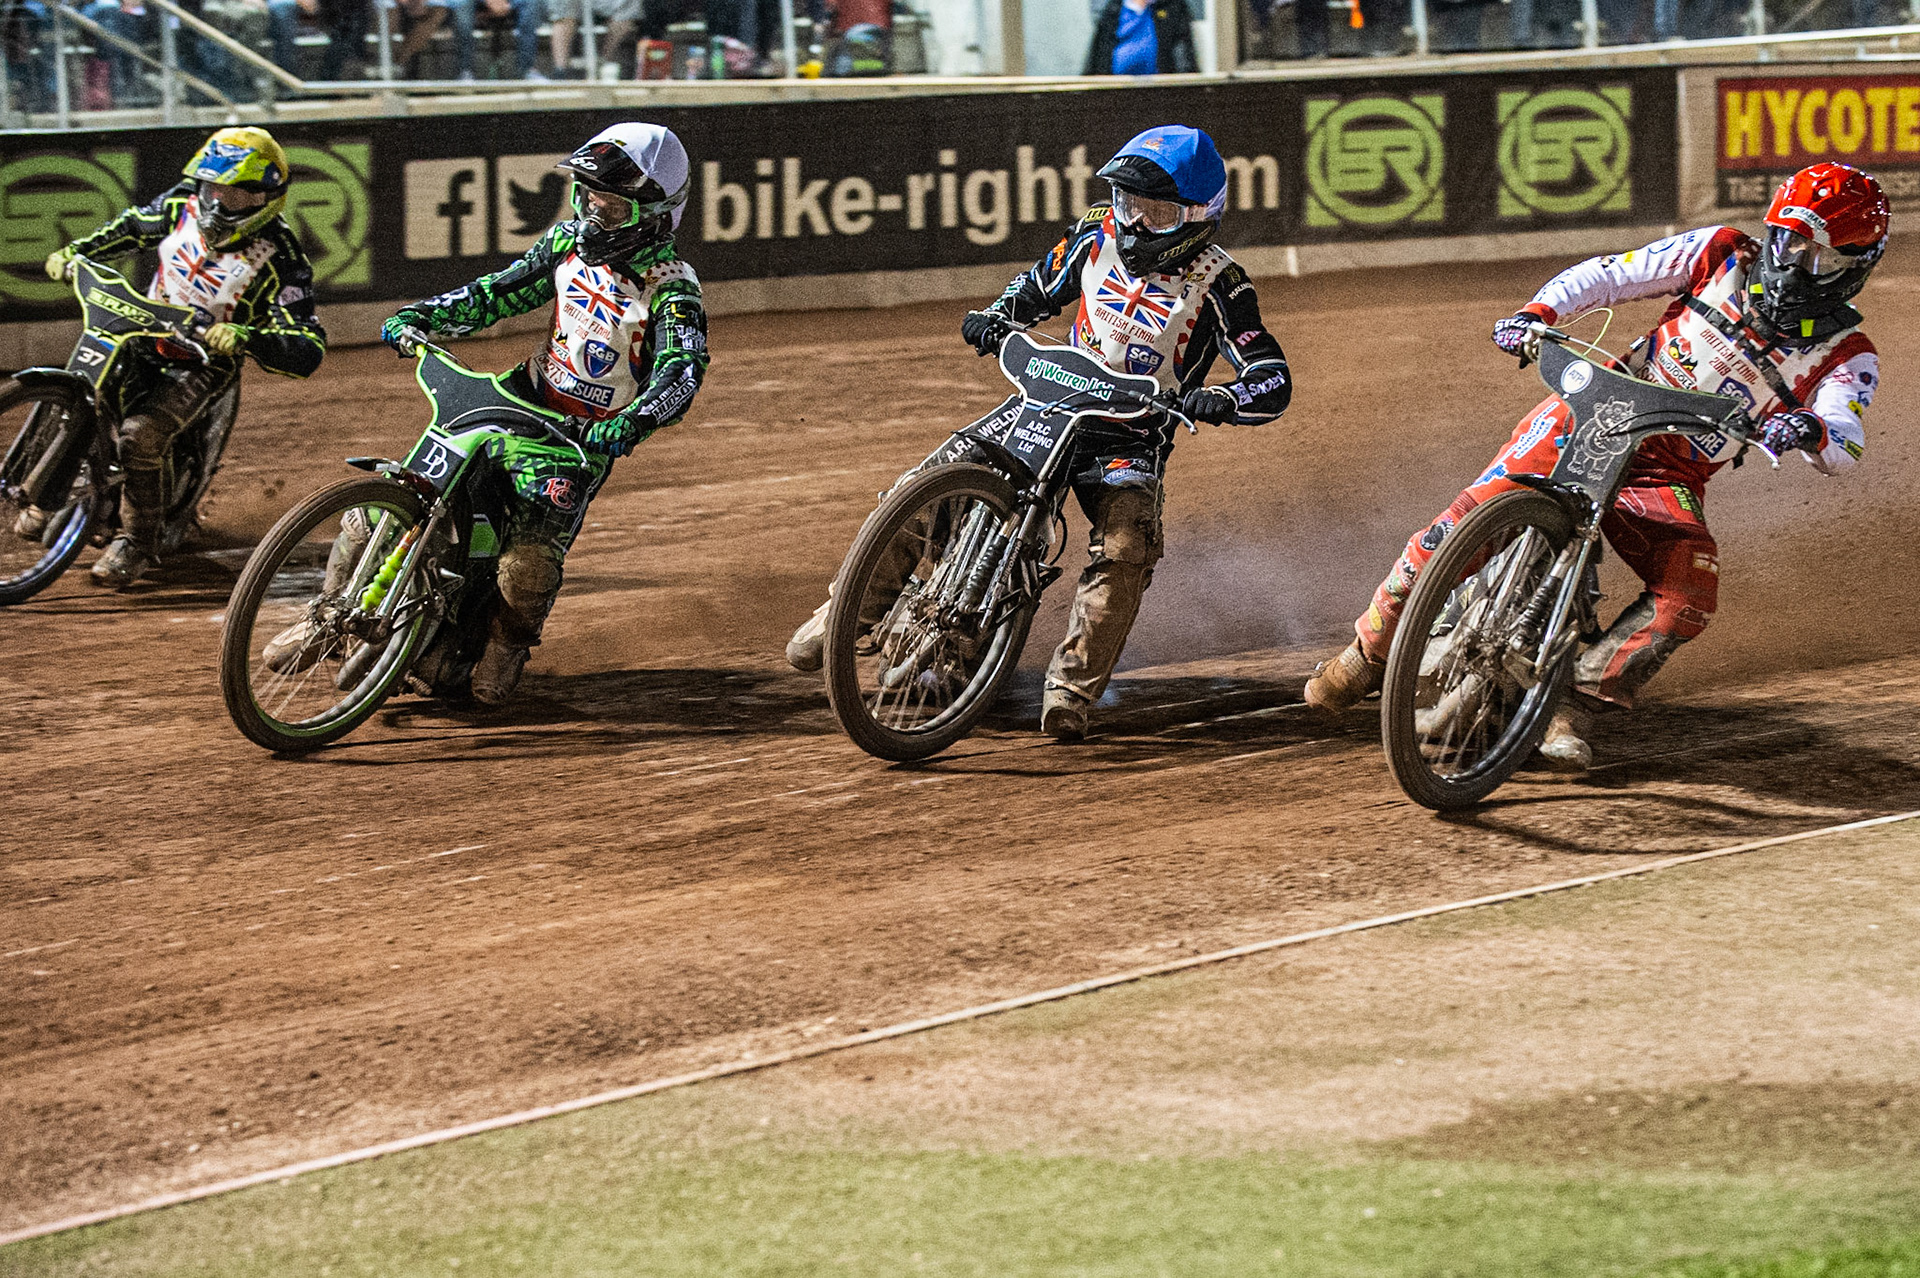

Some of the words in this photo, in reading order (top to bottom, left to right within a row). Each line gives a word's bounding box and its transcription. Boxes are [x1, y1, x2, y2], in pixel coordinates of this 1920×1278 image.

[562, 302, 590, 326] BRITISH
[1094, 306, 1128, 331] BRITISH
[574, 325, 590, 341] 2019
[590, 320, 612, 341] FINAL
[1109, 329, 1130, 346] 2019
[1128, 324, 1155, 344] FINAL
[586, 342, 616, 362] SGB
[1129, 346, 1160, 366] SGB
[1699, 327, 1736, 363] BRITISH
[77, 346, 106, 368] 37
[1708, 355, 1732, 377] 2019
[1041, 360, 1089, 393] Warren
[1086, 377, 1116, 402] Ltd
[1732, 357, 1760, 386] FINAL
[1013, 426, 1054, 450] WELDING
[1017, 440, 1036, 454] Ltd
